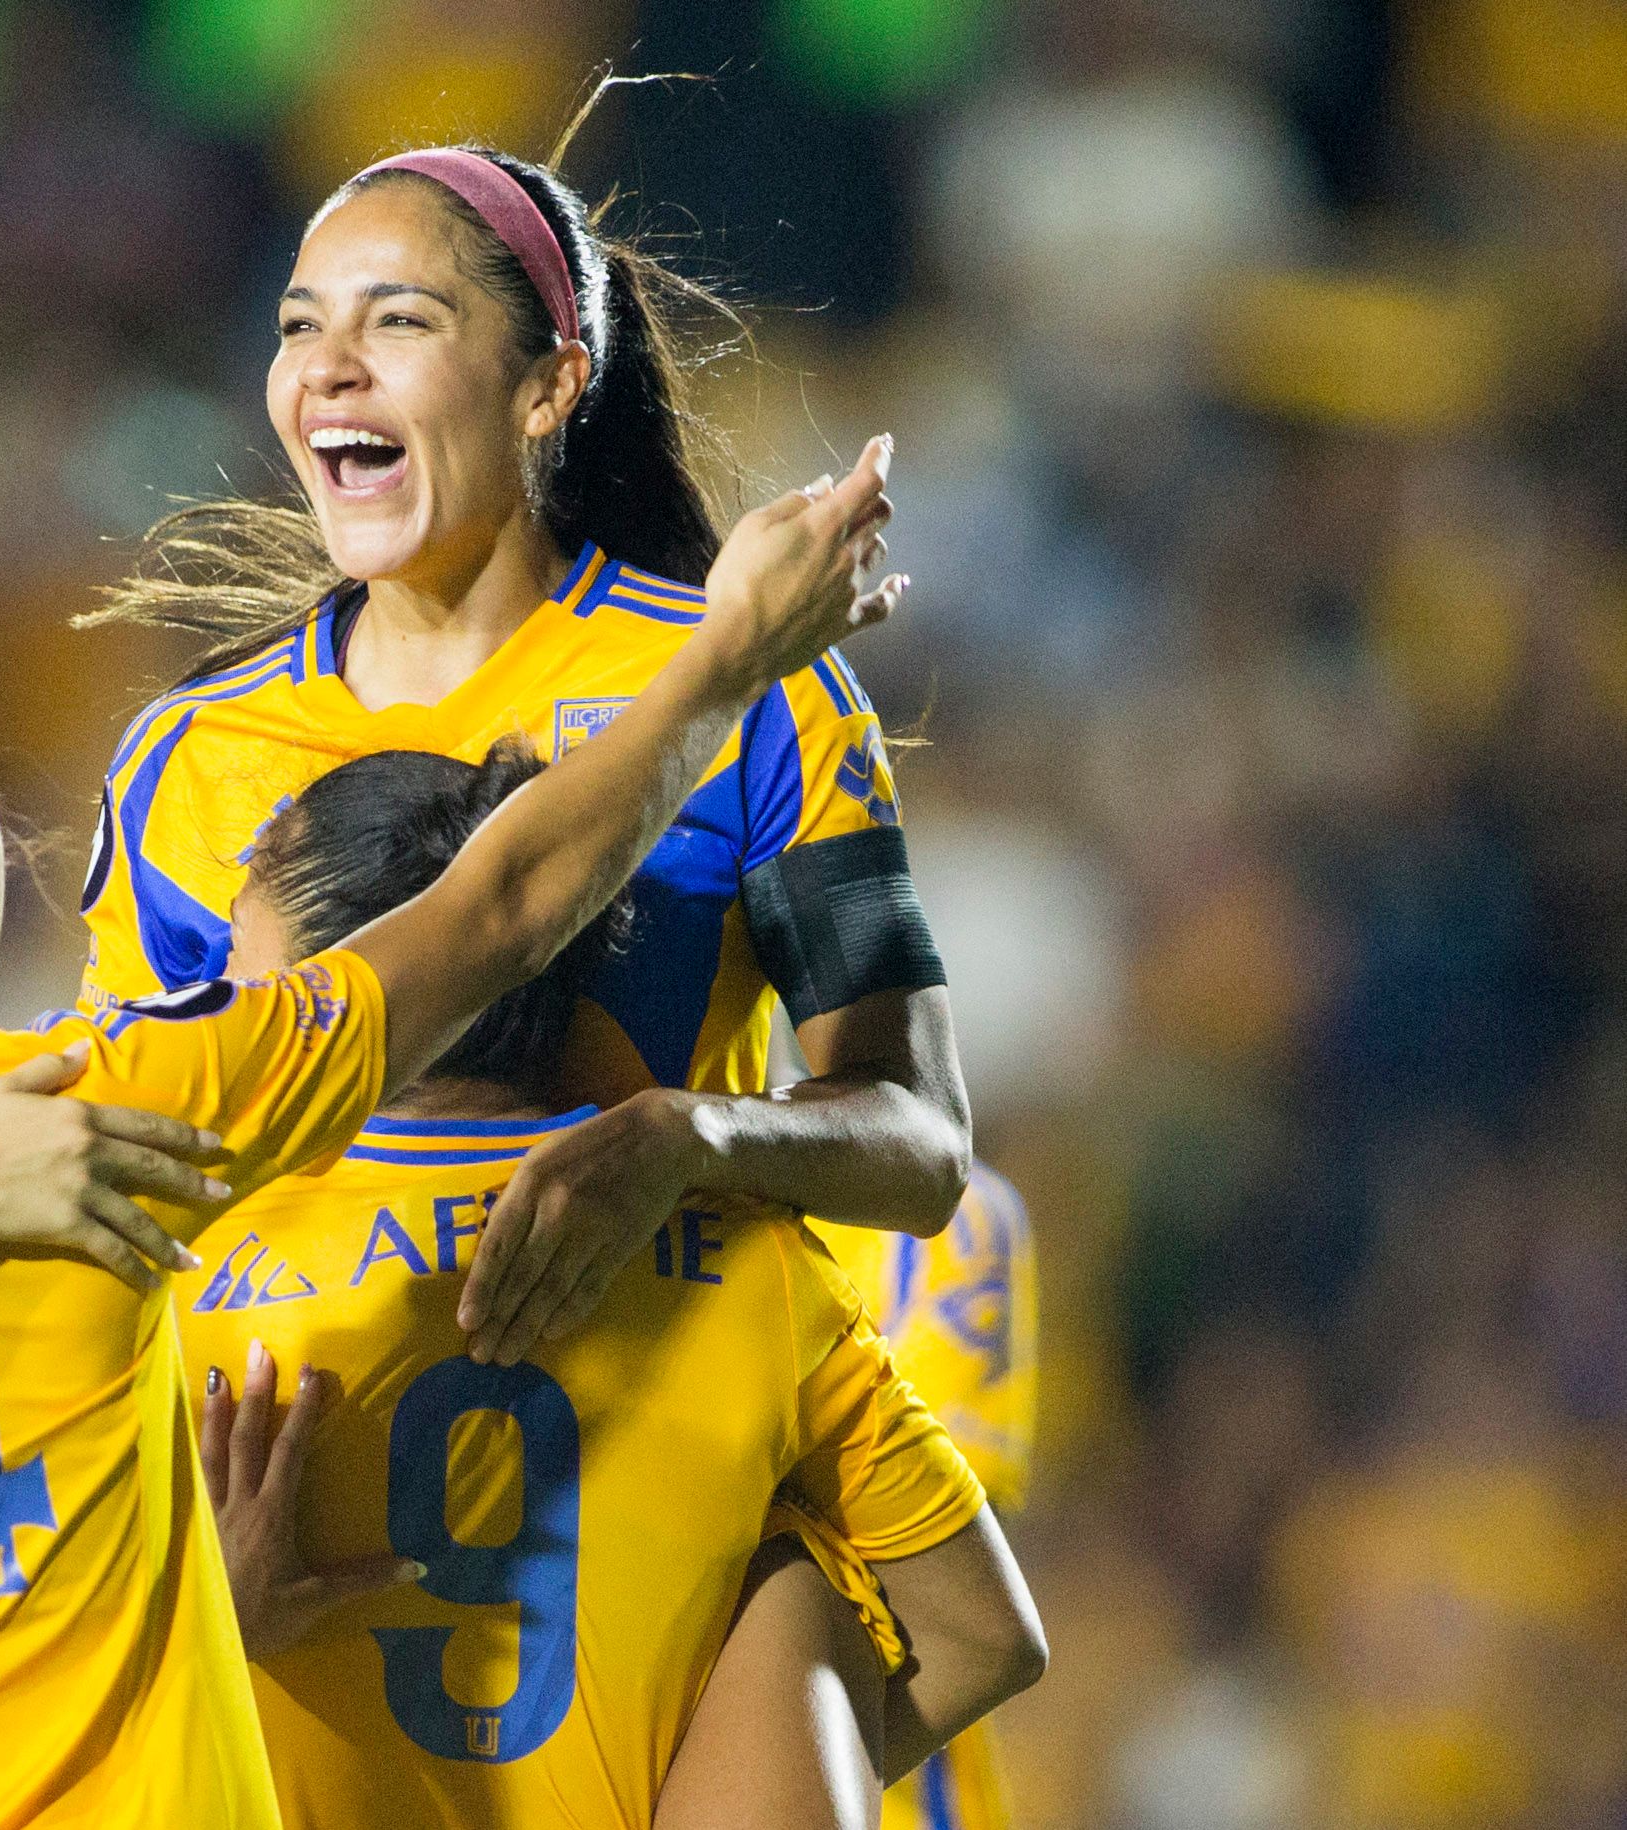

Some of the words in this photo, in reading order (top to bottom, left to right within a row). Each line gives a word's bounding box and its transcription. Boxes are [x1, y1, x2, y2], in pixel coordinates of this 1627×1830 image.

[564, 707, 623, 727] TIGRE
[348, 1192, 724, 1286] AFE
[372, 1355, 580, 1764] 9
